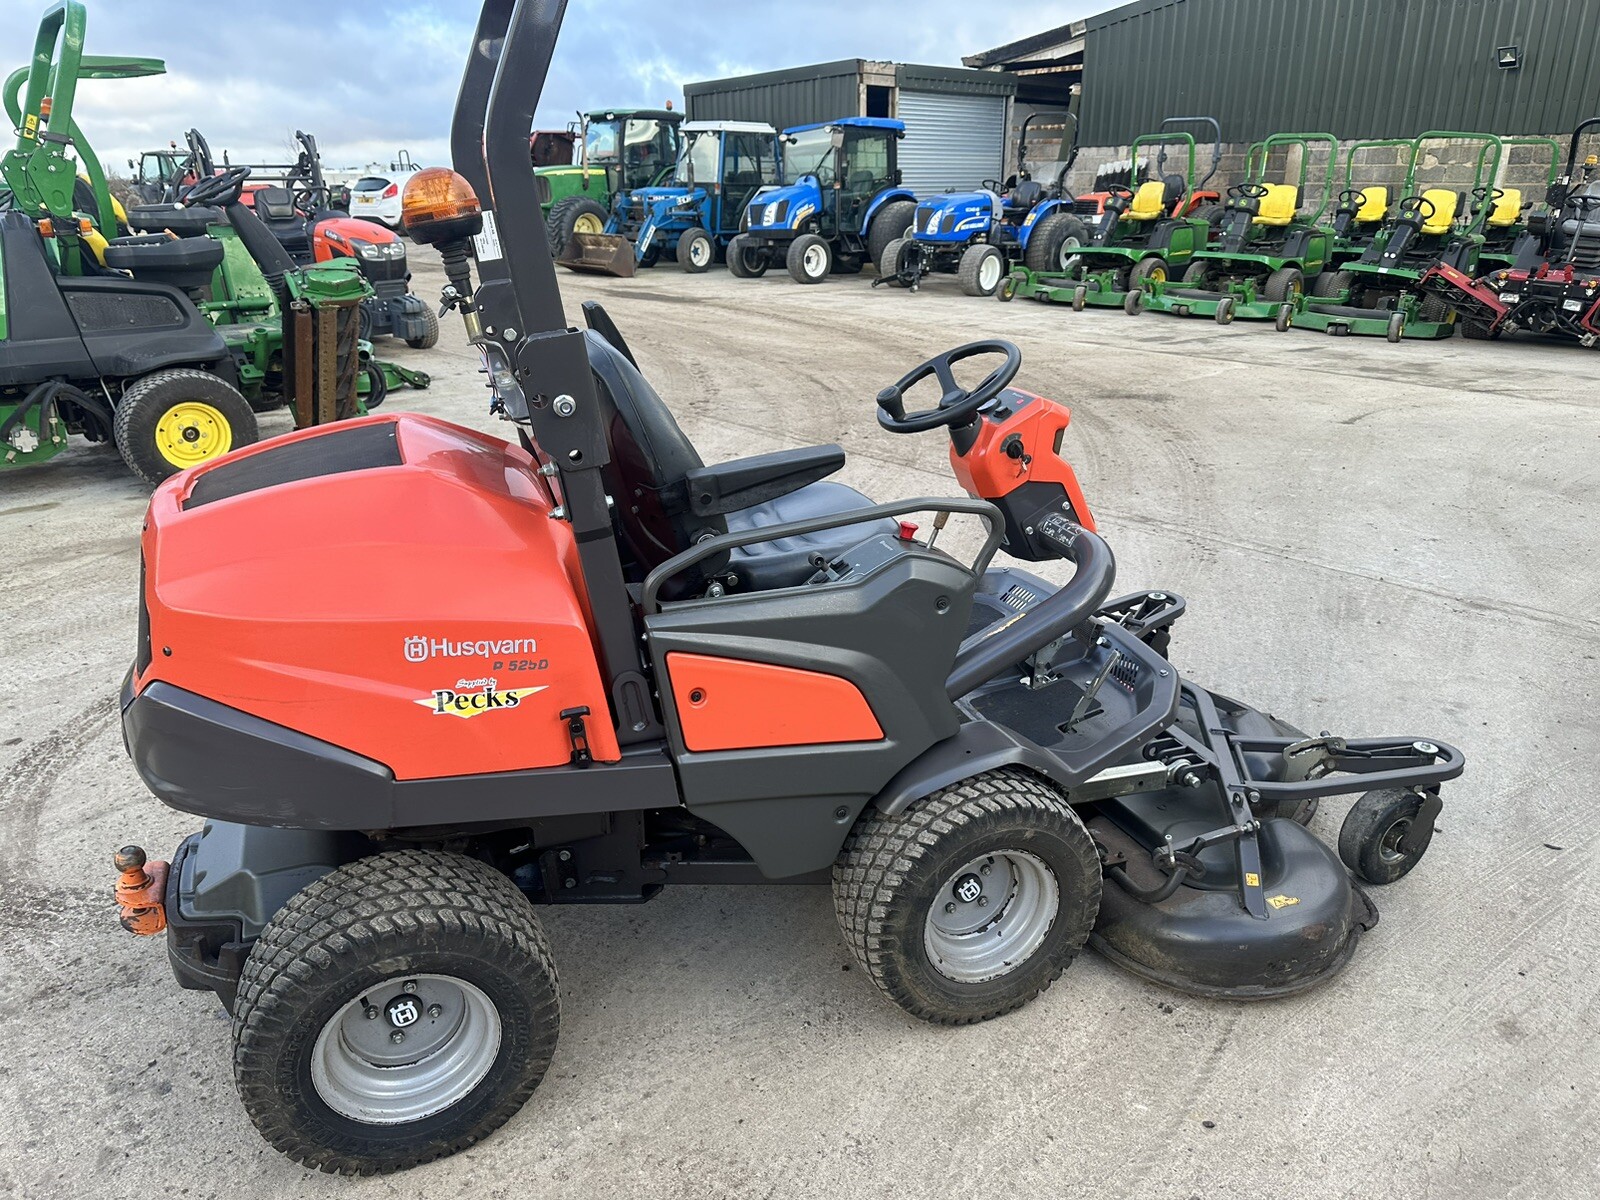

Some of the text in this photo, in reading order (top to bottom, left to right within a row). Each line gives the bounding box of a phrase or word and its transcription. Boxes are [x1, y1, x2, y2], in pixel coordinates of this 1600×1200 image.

[430, 638, 537, 658] Husqvarn
[456, 678, 488, 688] Supplied
[435, 687, 519, 712] Pecks
